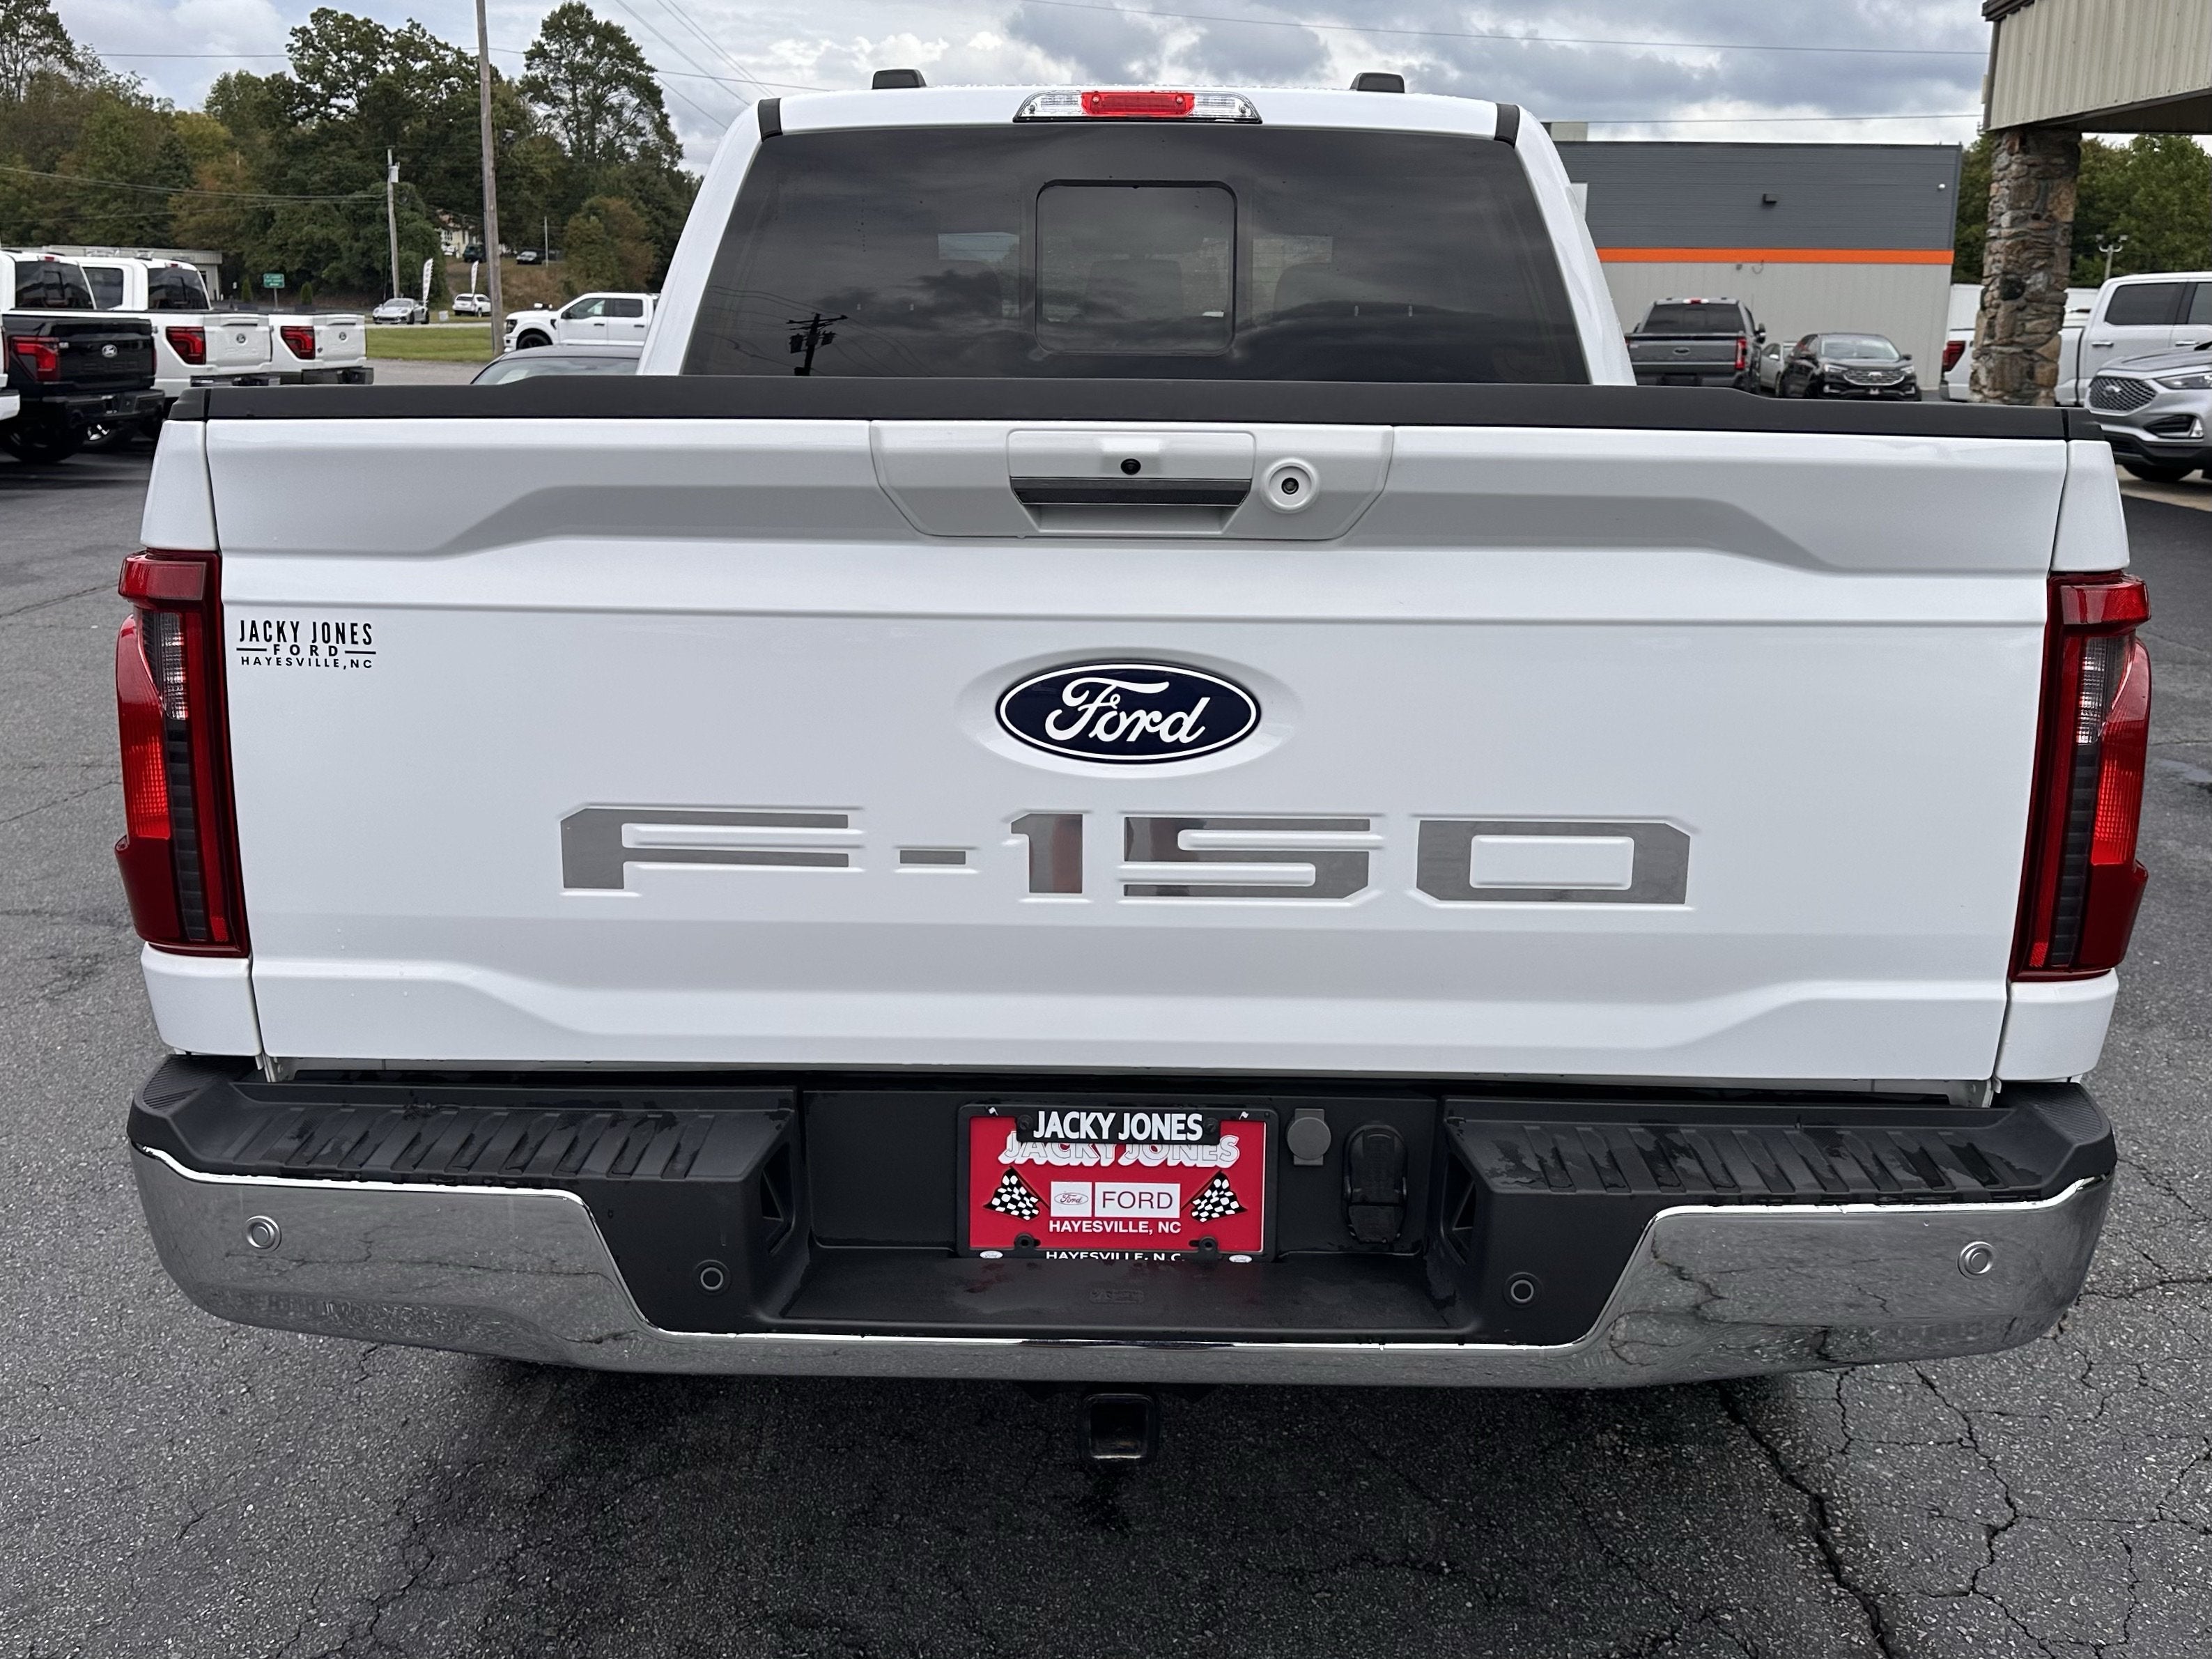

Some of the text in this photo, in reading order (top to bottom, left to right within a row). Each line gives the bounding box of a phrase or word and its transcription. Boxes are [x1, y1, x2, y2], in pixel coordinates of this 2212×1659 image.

[240, 620, 372, 645] JACKY JONES
[273, 644, 338, 657] FORD
[1045, 677, 1211, 743] Ford
[559, 806, 1692, 907] F-150
[1033, 1111, 1202, 1141] JACKY JONES
[1102, 1191, 1173, 1209] FORD
[1049, 1220, 1182, 1235] HAYESVILLE, NC
